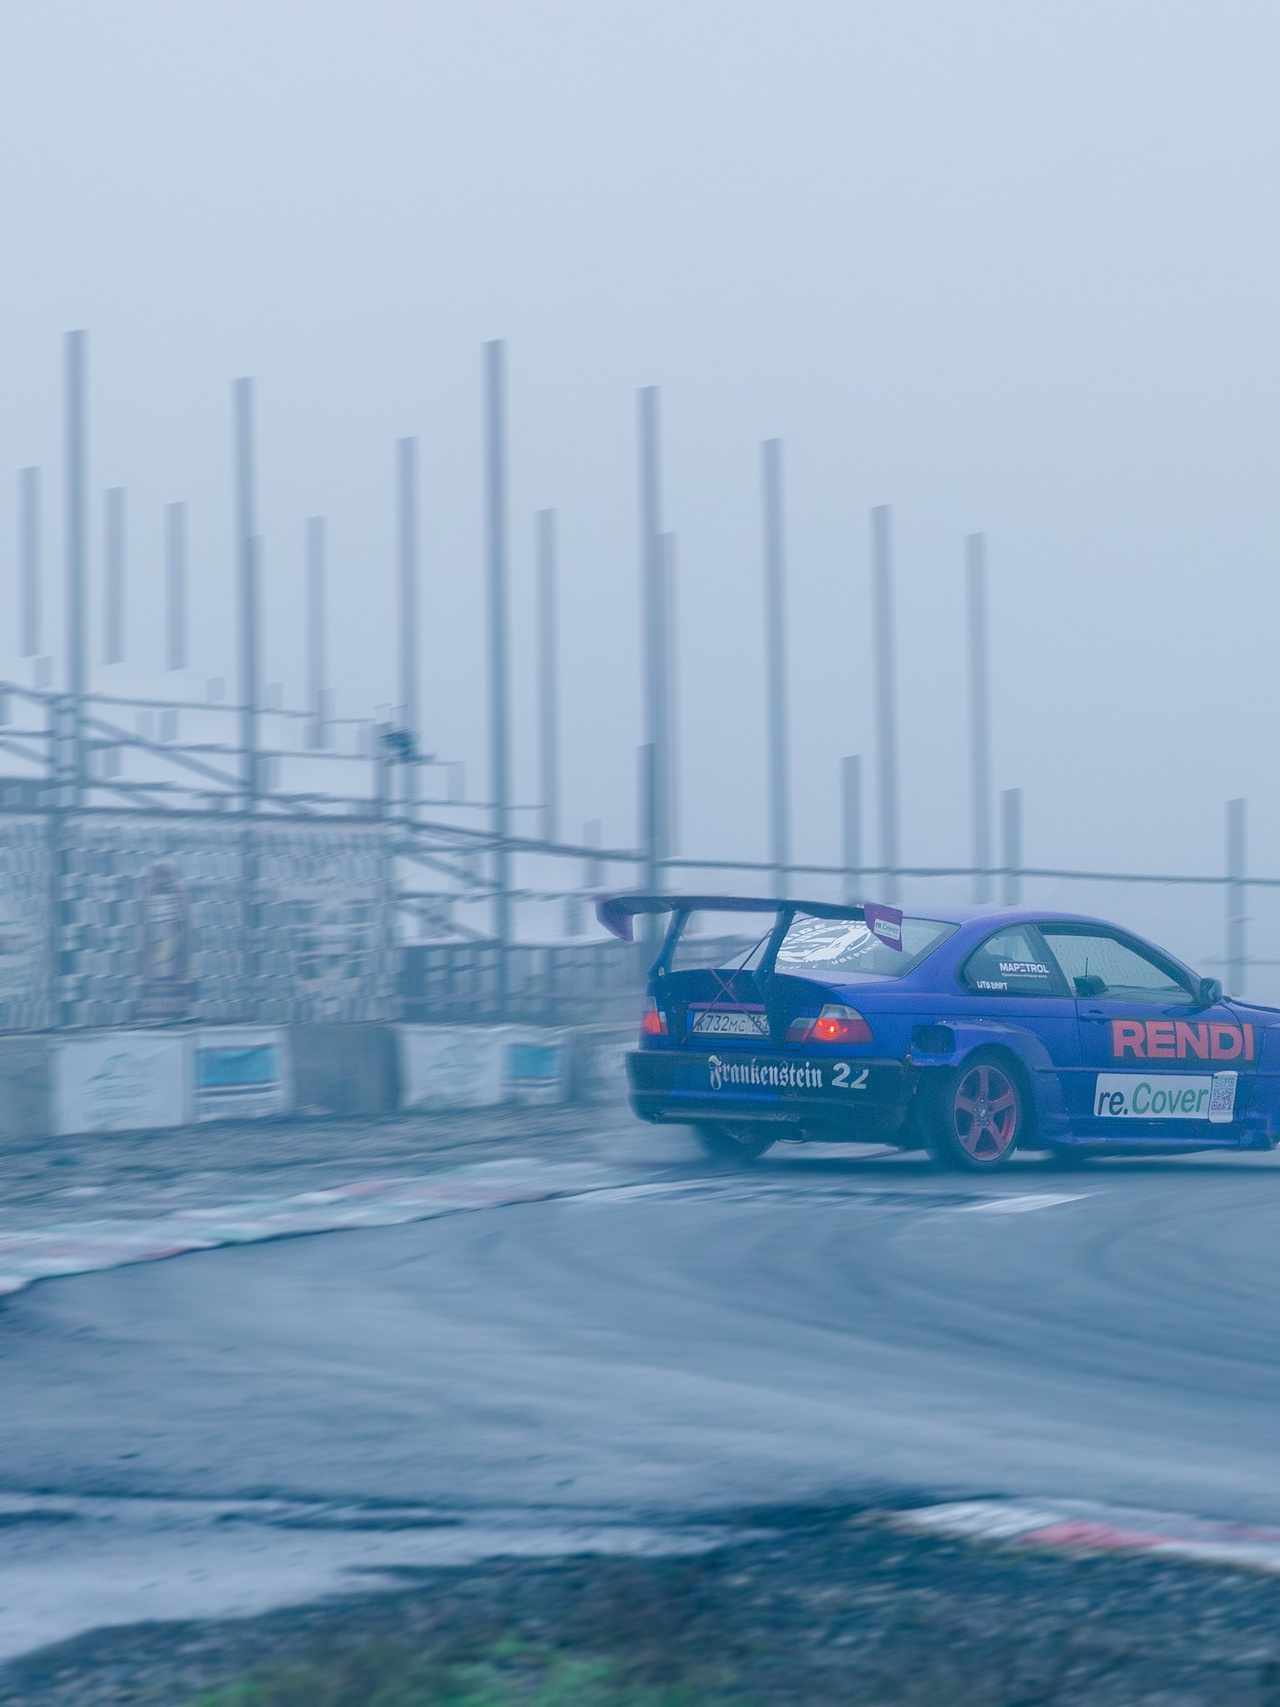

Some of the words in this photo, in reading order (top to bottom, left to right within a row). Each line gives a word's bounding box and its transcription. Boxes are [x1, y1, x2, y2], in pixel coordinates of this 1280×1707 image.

[1111, 1020, 1255, 1061] RENDI
[707, 1055, 824, 1091] Frankenstein
[831, 1062, 870, 1090] 22
[1097, 1082, 1209, 1116] re.Cover
